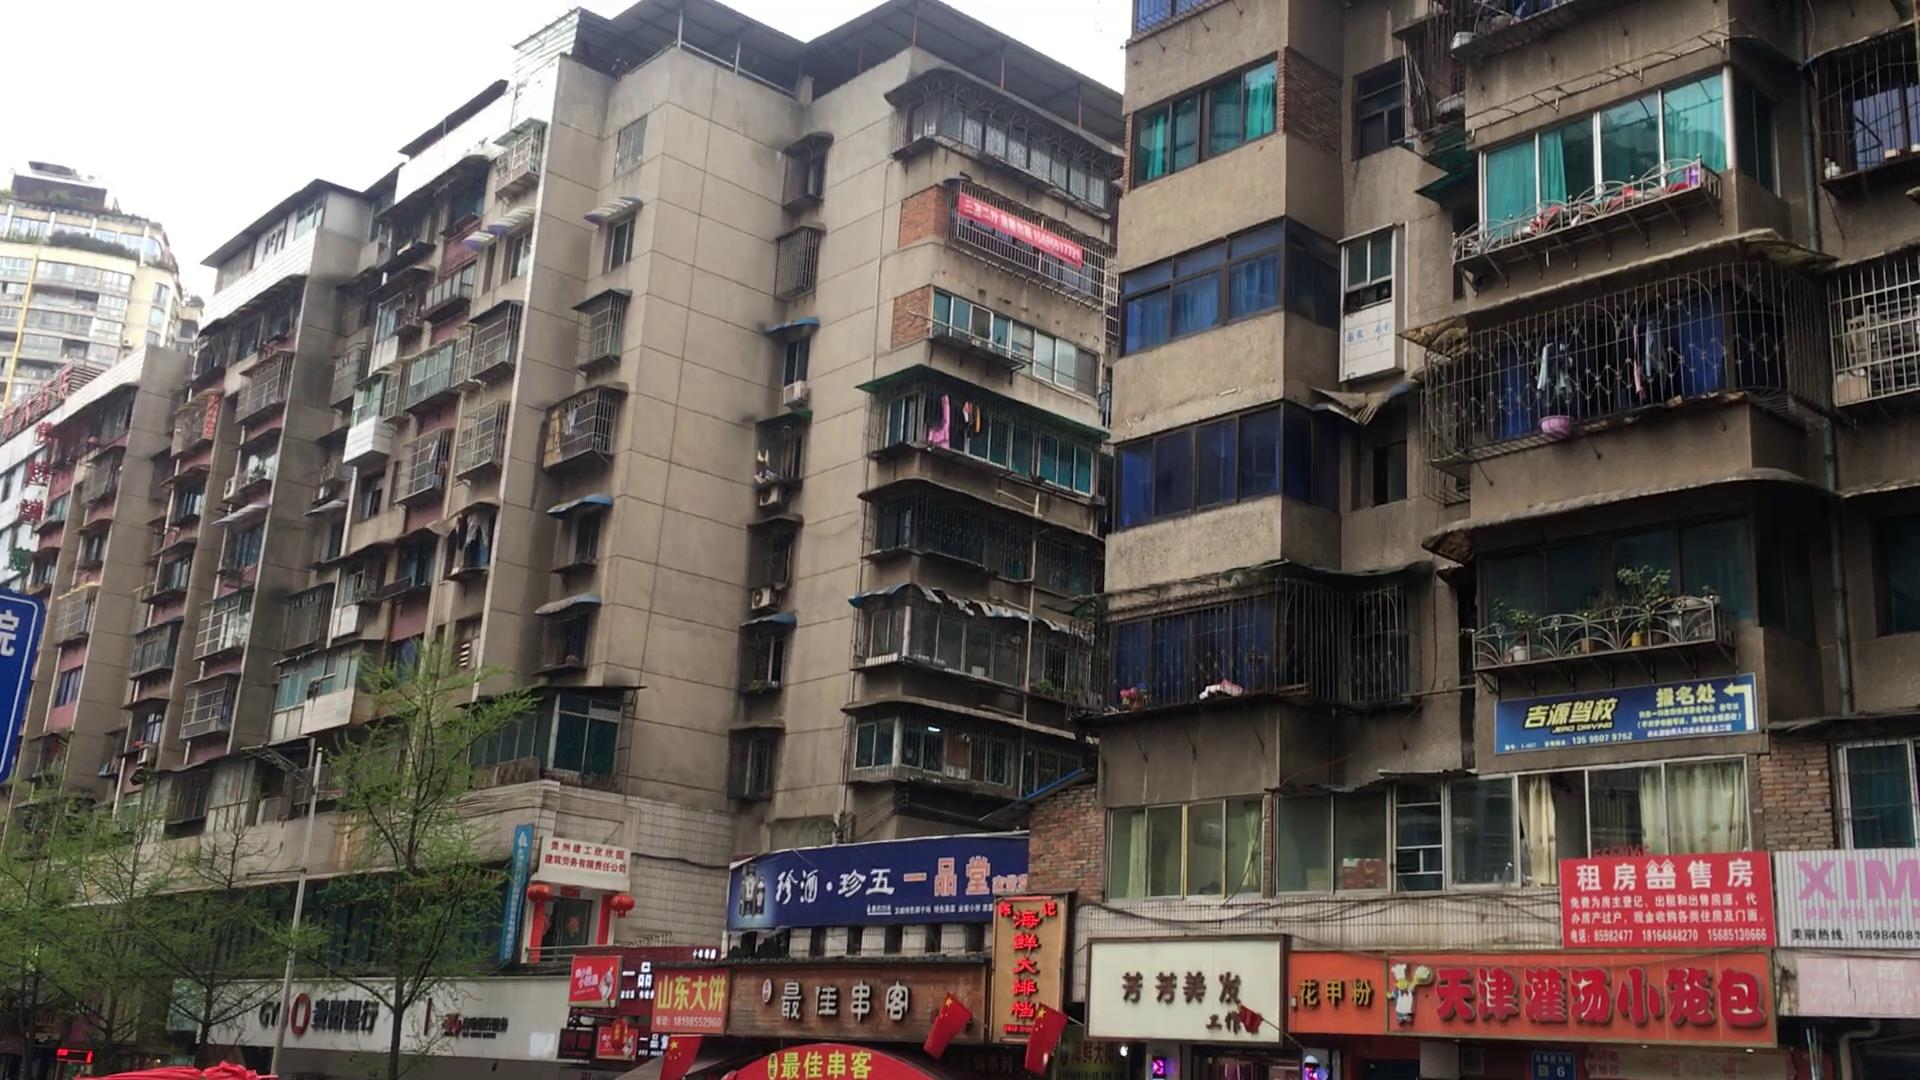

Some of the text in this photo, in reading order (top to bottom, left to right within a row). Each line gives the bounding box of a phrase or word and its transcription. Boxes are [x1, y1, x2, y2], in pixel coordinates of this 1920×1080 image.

[1524, 697, 1618, 728] 吉源驾校
[1656, 683, 1716, 708] 报名处
[544, 854, 627, 874] 建筑劳务有限责任公司
[903, 855, 991, 896] 一品堂
[1576, 858, 1753, 892] 租房 售房
[1012, 910, 1040, 1018] 海鲜大排档
[656, 974, 727, 1011] 山东大饼
[780, 980, 909, 1022] 最佳串客
[1122, 971, 1241, 1005] 芳芳美发
[1299, 978, 1374, 1009] 花甲粉
[1435, 966, 1766, 1028] 天津灌汤小笼包
[781, 1050, 872, 1080] 最佳串客
[1556, 1065, 1566, 1078] 6
